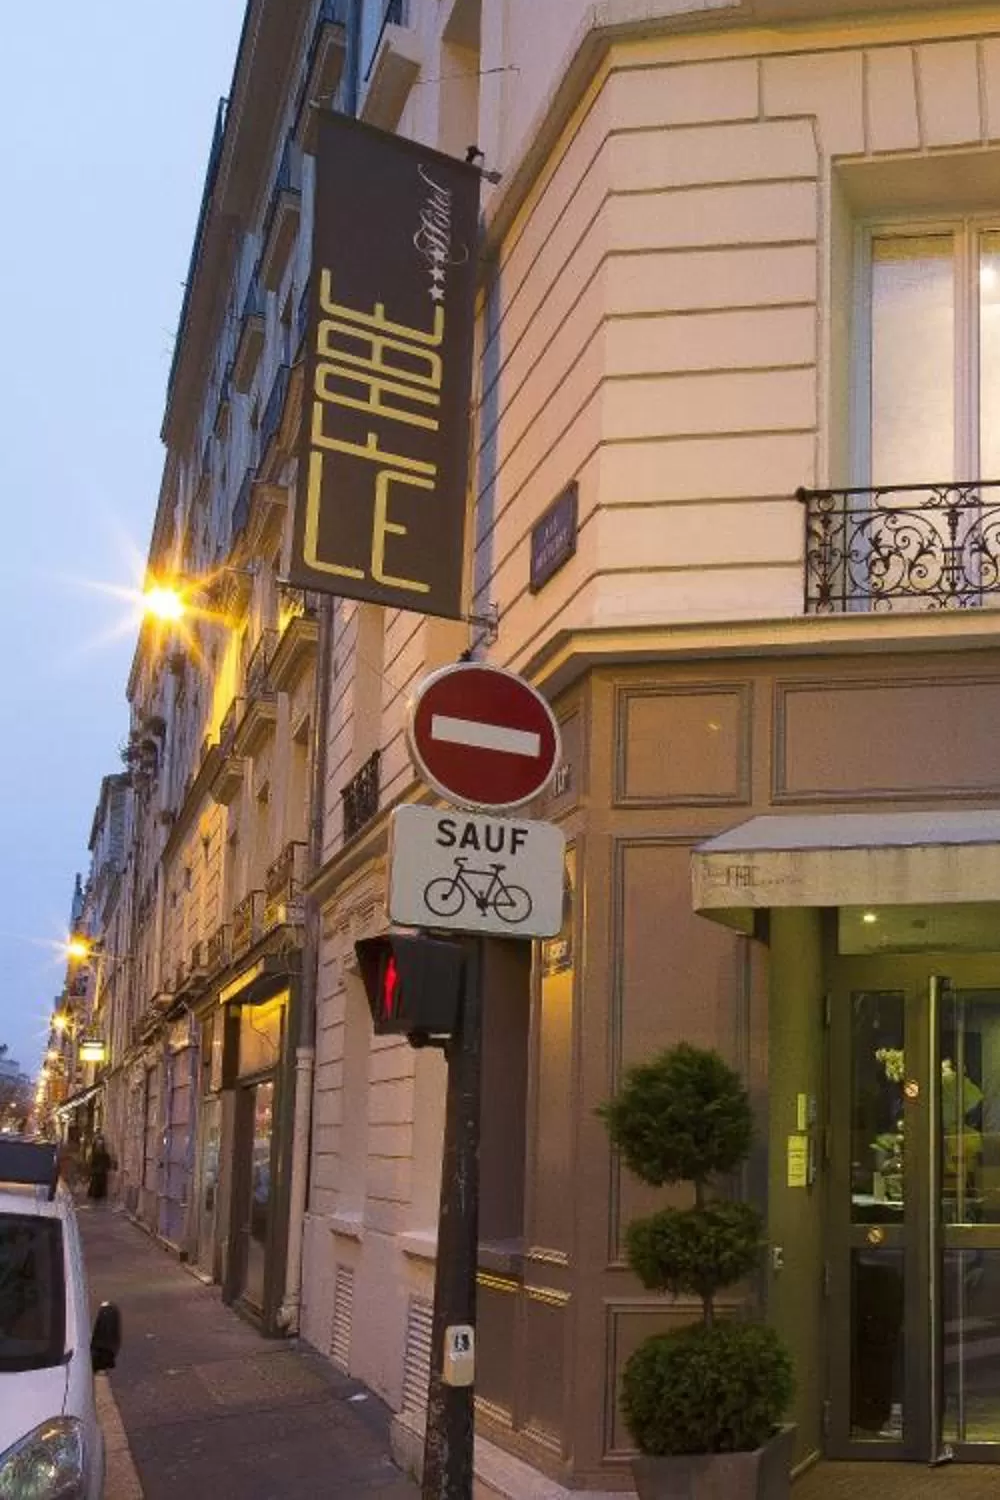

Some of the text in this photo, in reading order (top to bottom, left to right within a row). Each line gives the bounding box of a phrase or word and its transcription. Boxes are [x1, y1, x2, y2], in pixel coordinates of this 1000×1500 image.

[303, 267, 445, 594] LE FABE
[435, 818, 529, 856] SAUF
